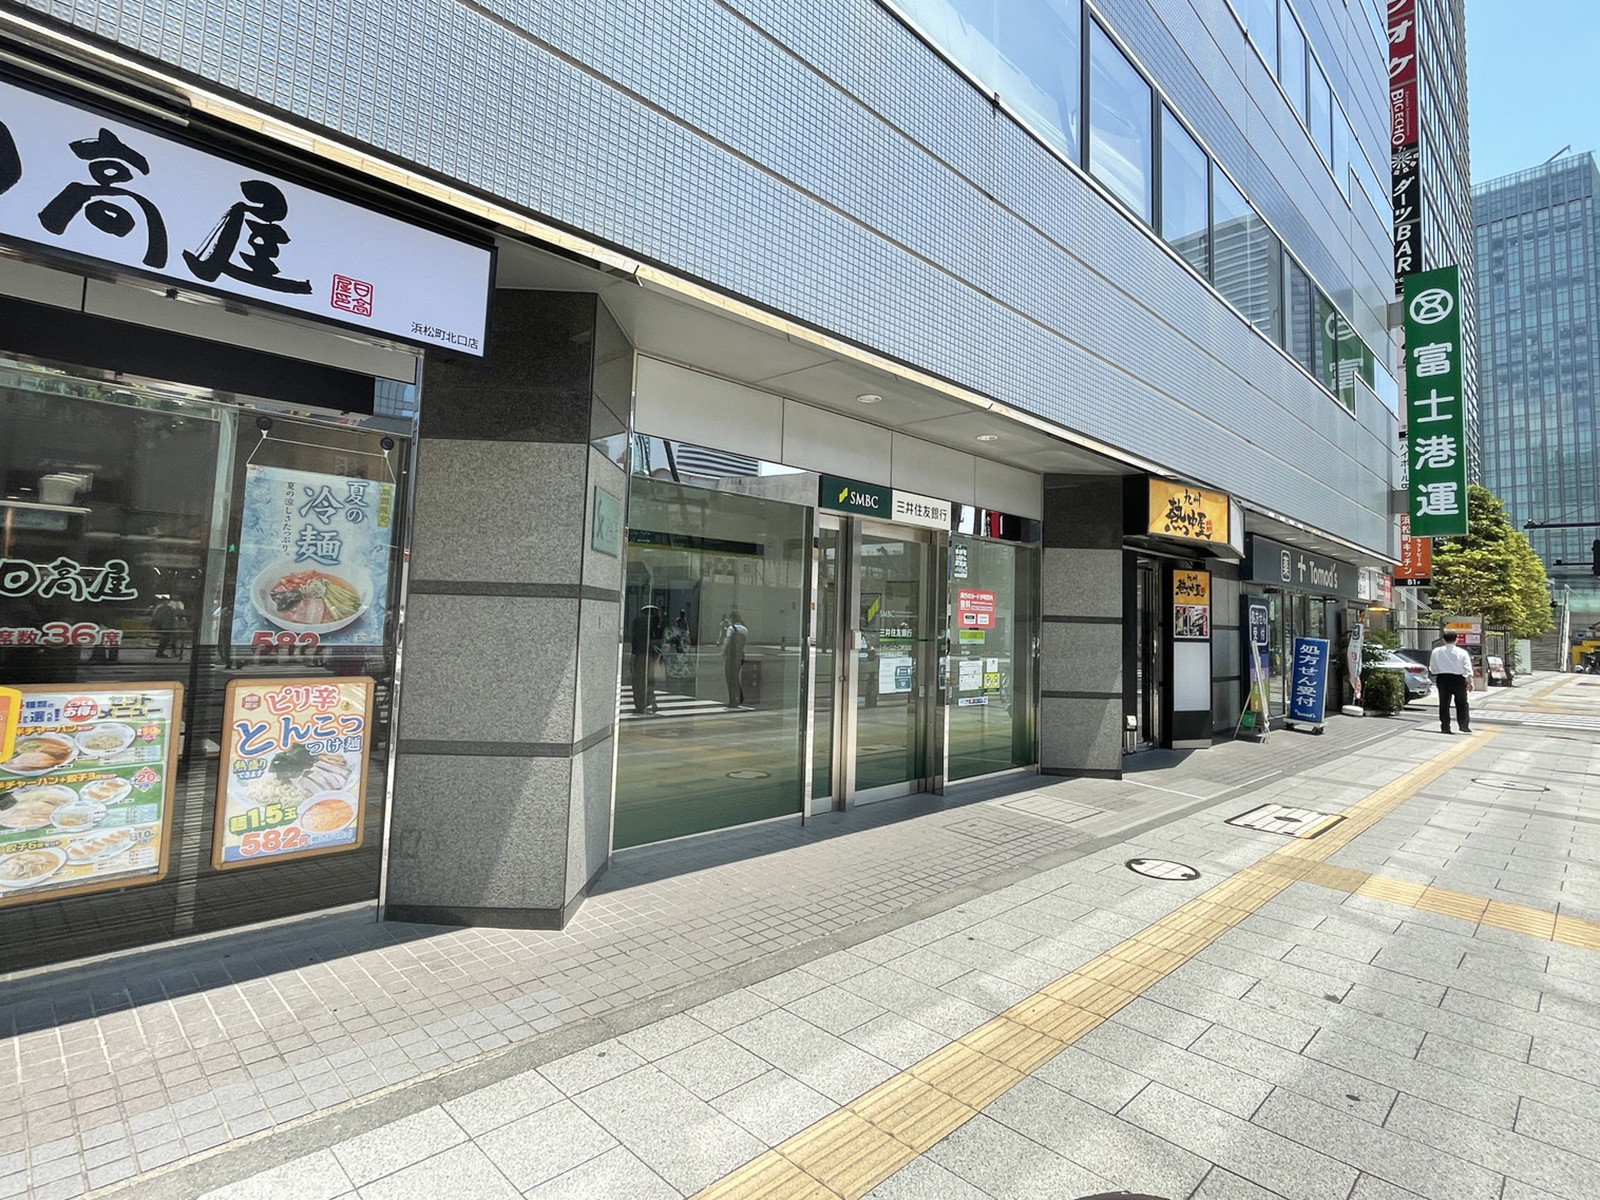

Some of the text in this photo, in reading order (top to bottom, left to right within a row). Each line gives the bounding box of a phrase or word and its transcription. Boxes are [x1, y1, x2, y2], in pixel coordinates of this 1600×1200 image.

[1395, 224, 1412, 274] BAR
[411, 321, 479, 350] 浜松町北口店
[1413, 342, 1460, 517] 富士港運
[346, 480, 370, 524] 夏の
[850, 491, 879, 509] SMBC
[896, 500, 947, 522] 三井住友銀行
[1184, 488, 1202, 509] 九州
[294, 484, 344, 567] 冷麺
[1164, 497, 1212, 540] 熱中屋
[1309, 561, 1338, 589] Tomod's
[879, 628, 912, 637] 三井住友銀行
[1296, 644, 1321, 707] 処方せん受付
[98, 707, 163, 719] メニュー
[267, 686, 339, 715] ピリ辛
[235, 716, 364, 757] とんこつ
[306, 736, 363, 755] つけ麺
[239, 828, 309, 856] 582円
